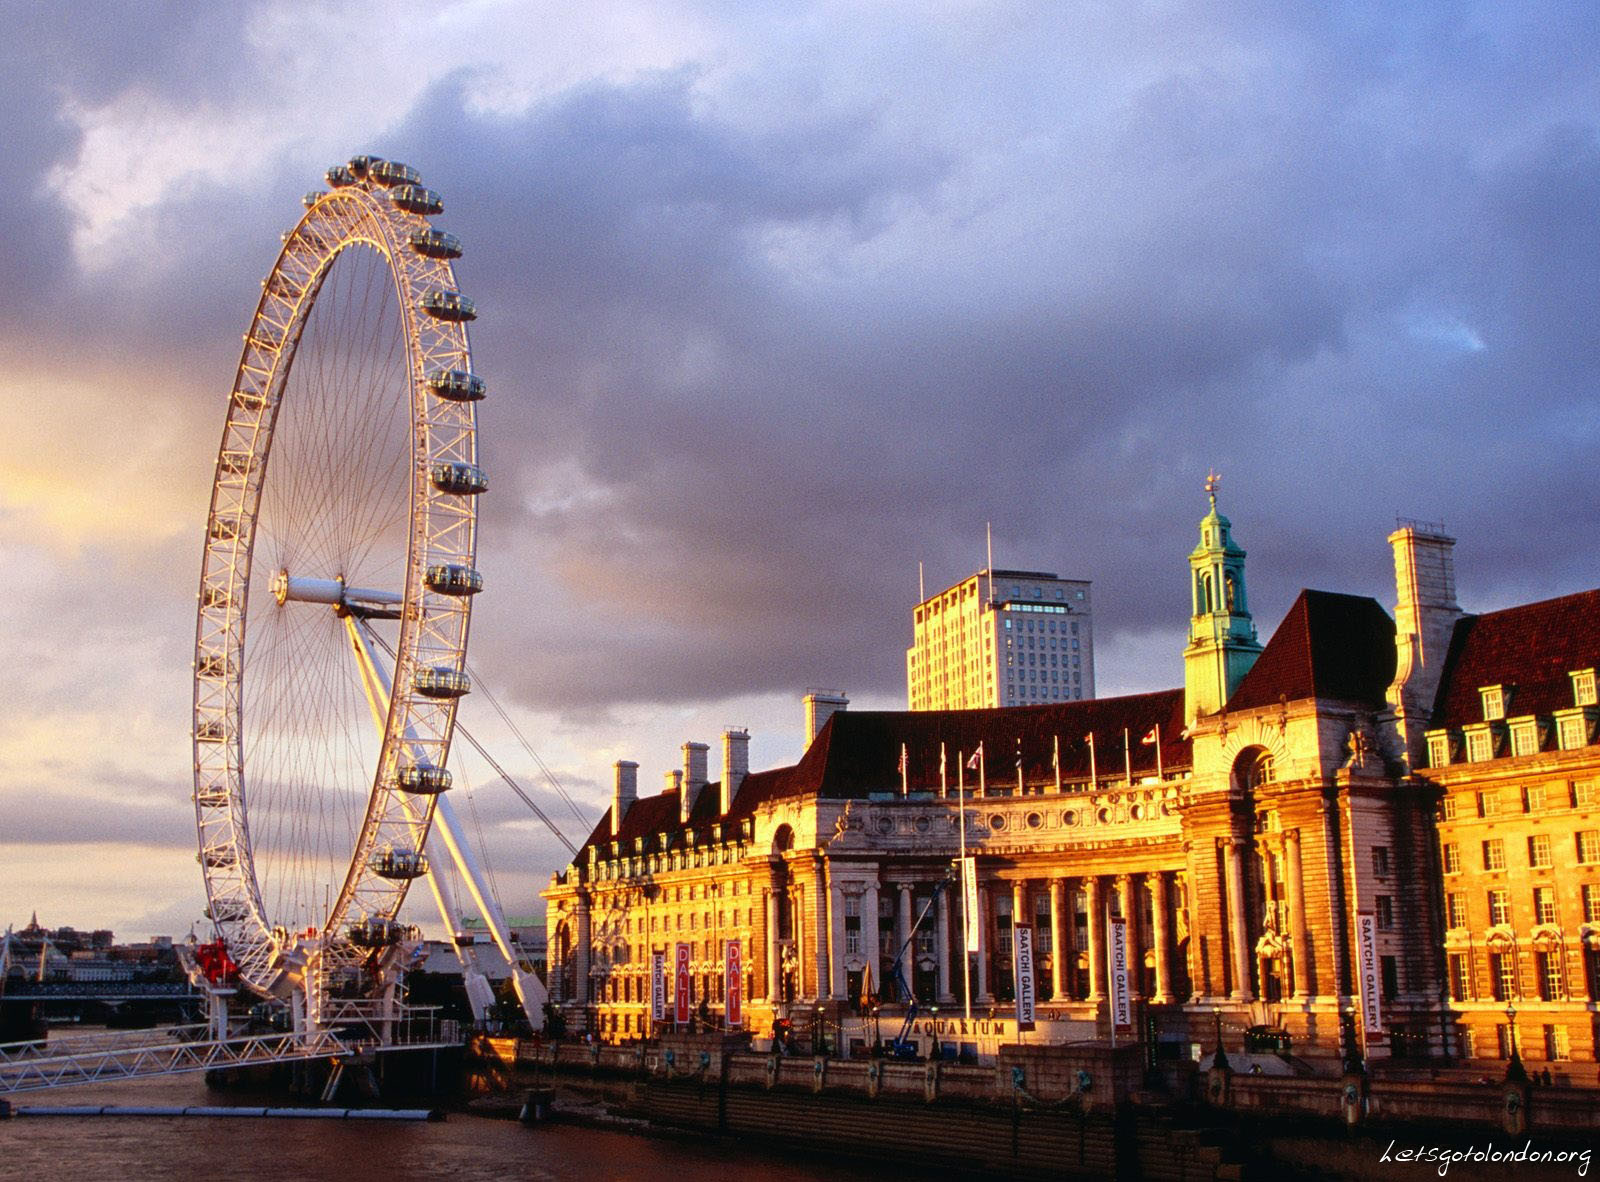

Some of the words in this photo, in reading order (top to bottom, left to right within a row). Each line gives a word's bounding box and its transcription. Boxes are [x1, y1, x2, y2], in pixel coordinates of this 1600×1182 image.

[1020, 928, 1030, 973] SAATCHI
[1114, 924, 1124, 971] SAATCHI
[1362, 918, 1374, 970] SAATCHI
[655, 987, 663, 1019] GALLERY
[1021, 975, 1032, 1023] GALLERY
[1116, 974, 1127, 1024] GALLERY
[1366, 973, 1378, 1029] GALLERY
[913, 1021, 1005, 1036] AQUARIUM
